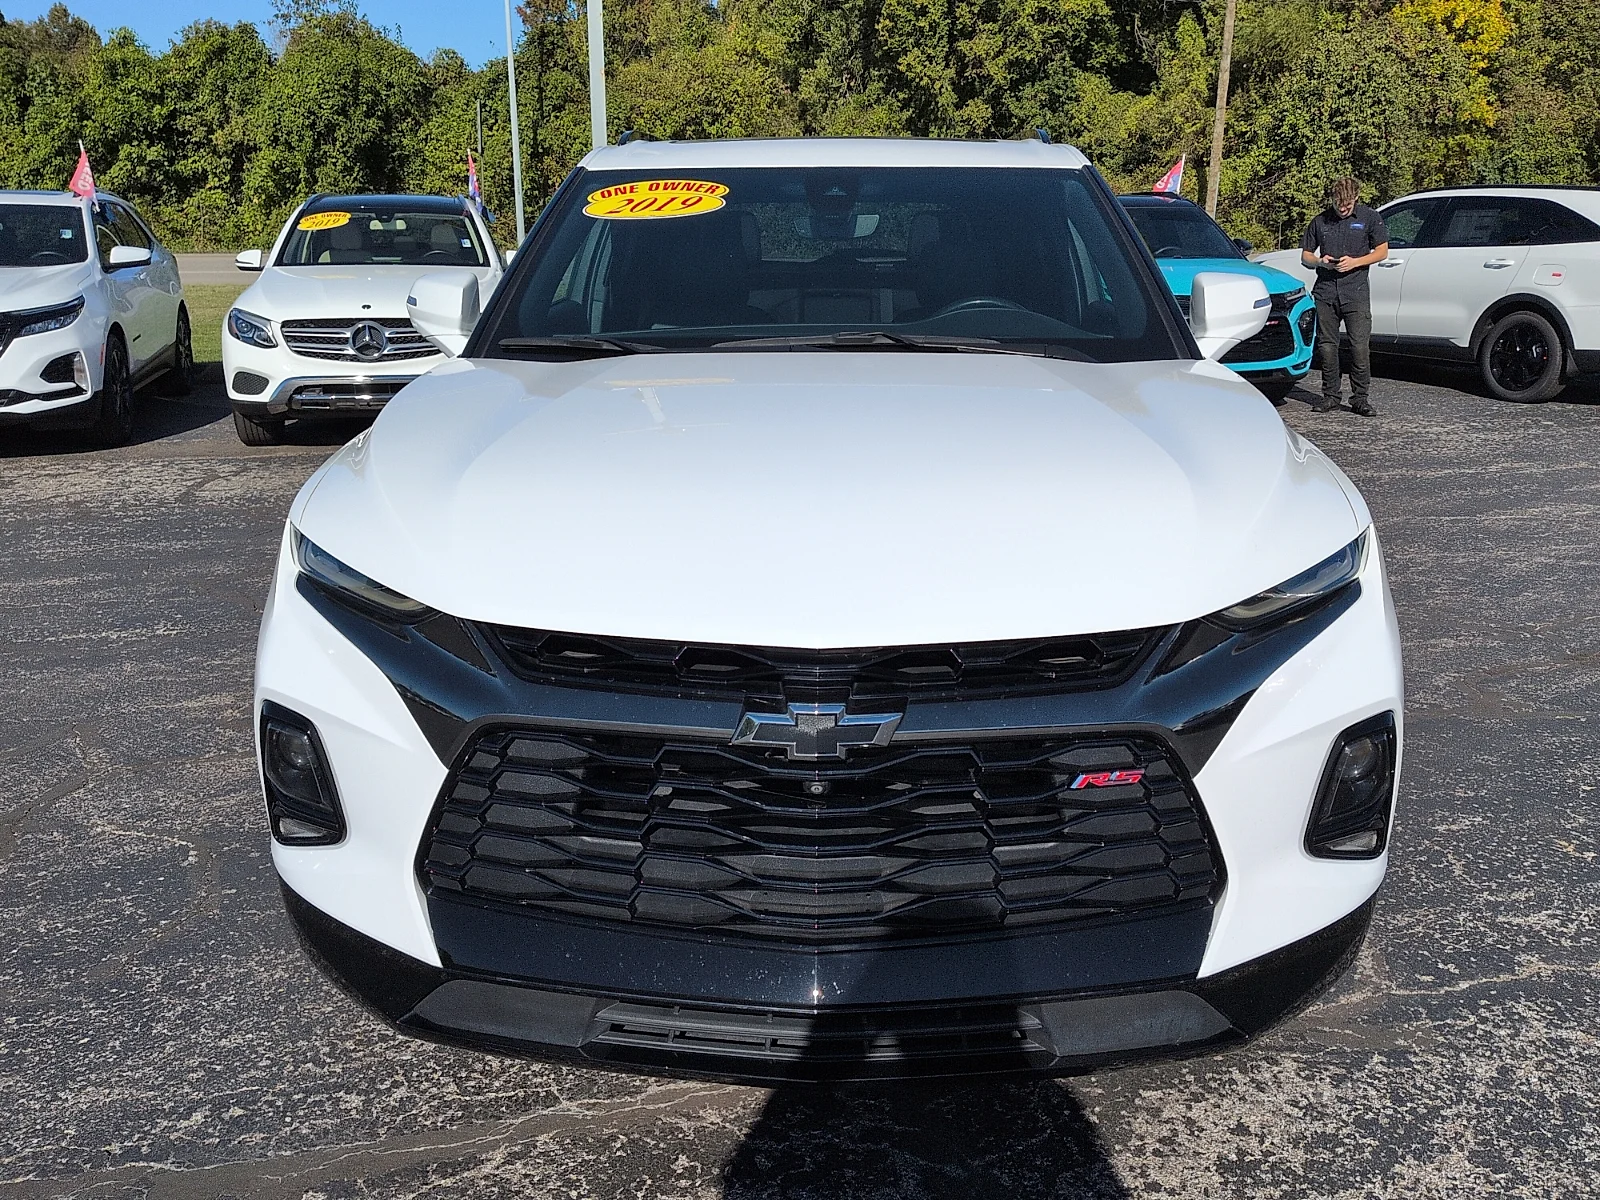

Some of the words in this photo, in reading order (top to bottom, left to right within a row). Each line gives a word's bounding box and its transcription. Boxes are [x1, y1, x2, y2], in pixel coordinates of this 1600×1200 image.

[600, 184, 639, 199] ONE
[648, 182, 720, 194] OWNER
[603, 195, 703, 215] 2019
[306, 218, 340, 228] 2019
[1070, 768, 1145, 789] RS
